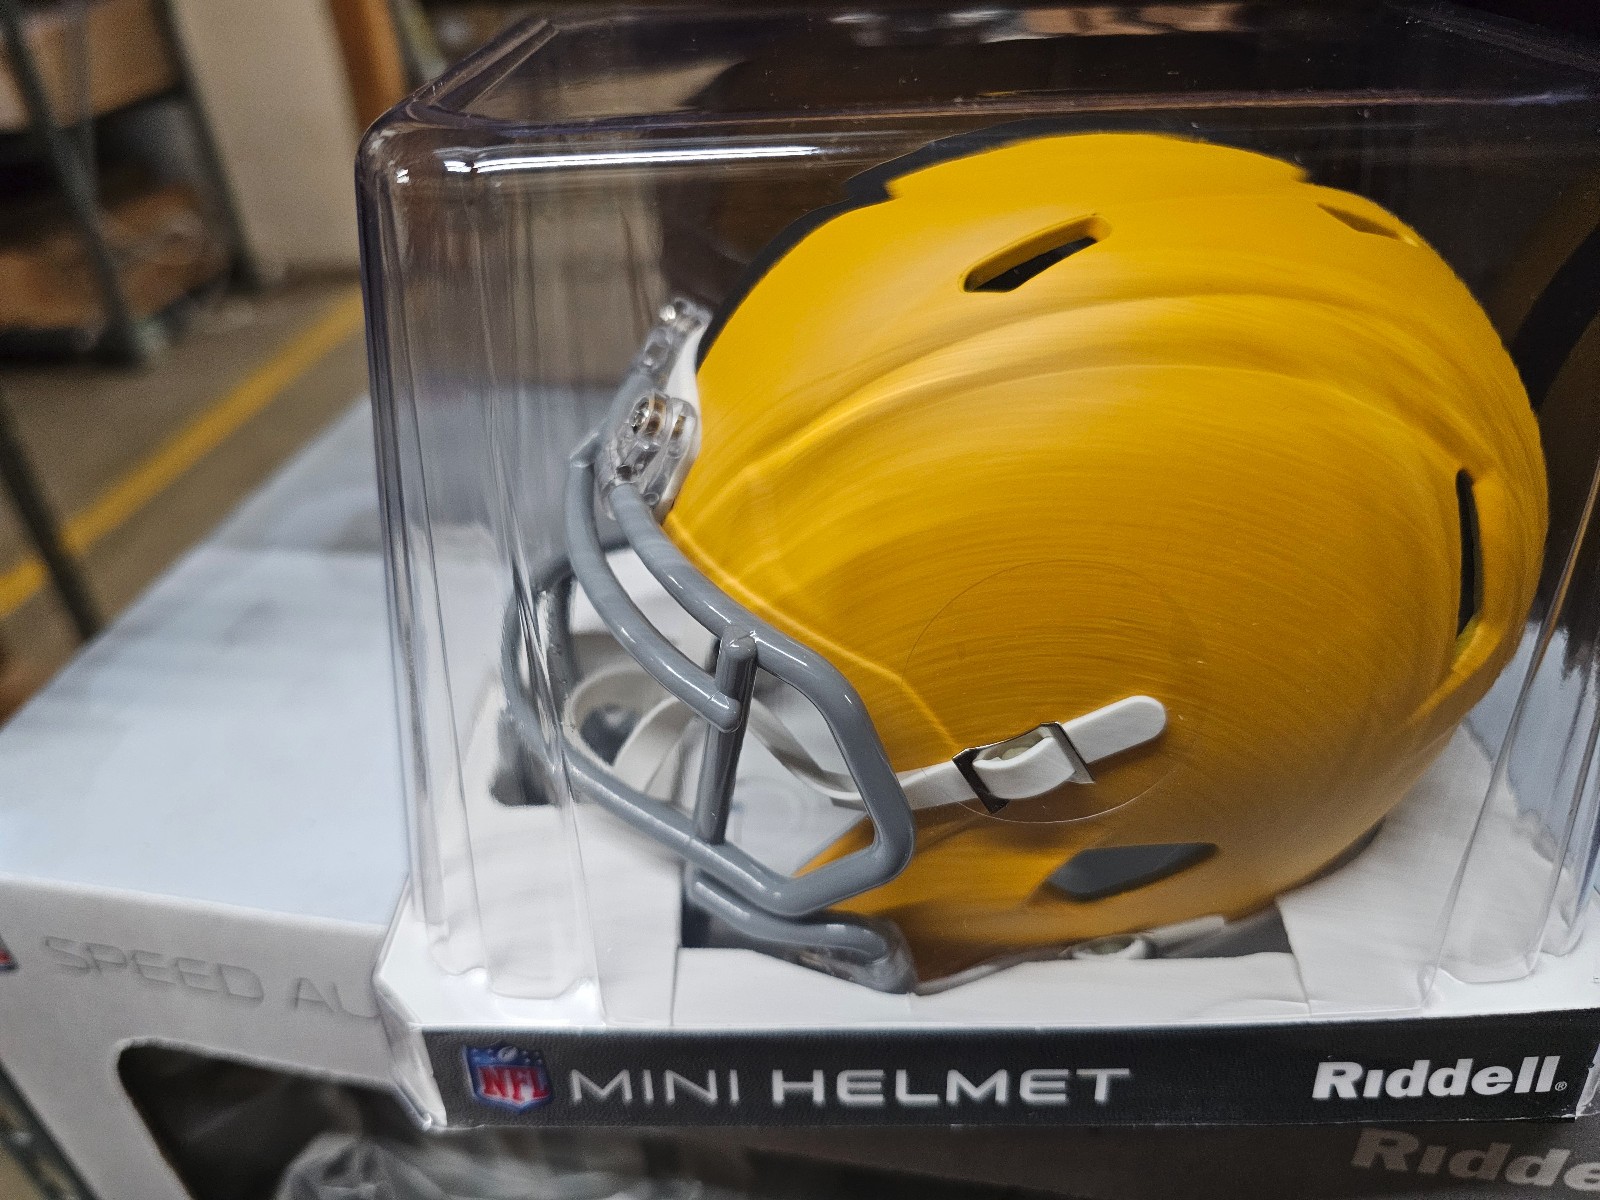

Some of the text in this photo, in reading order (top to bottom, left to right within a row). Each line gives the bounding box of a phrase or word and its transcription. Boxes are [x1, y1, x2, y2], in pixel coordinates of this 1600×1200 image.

[44, 935, 265, 1002] SPEED
[478, 1067, 550, 1104] NFL
[570, 1067, 1131, 1105] MINI HELMET
